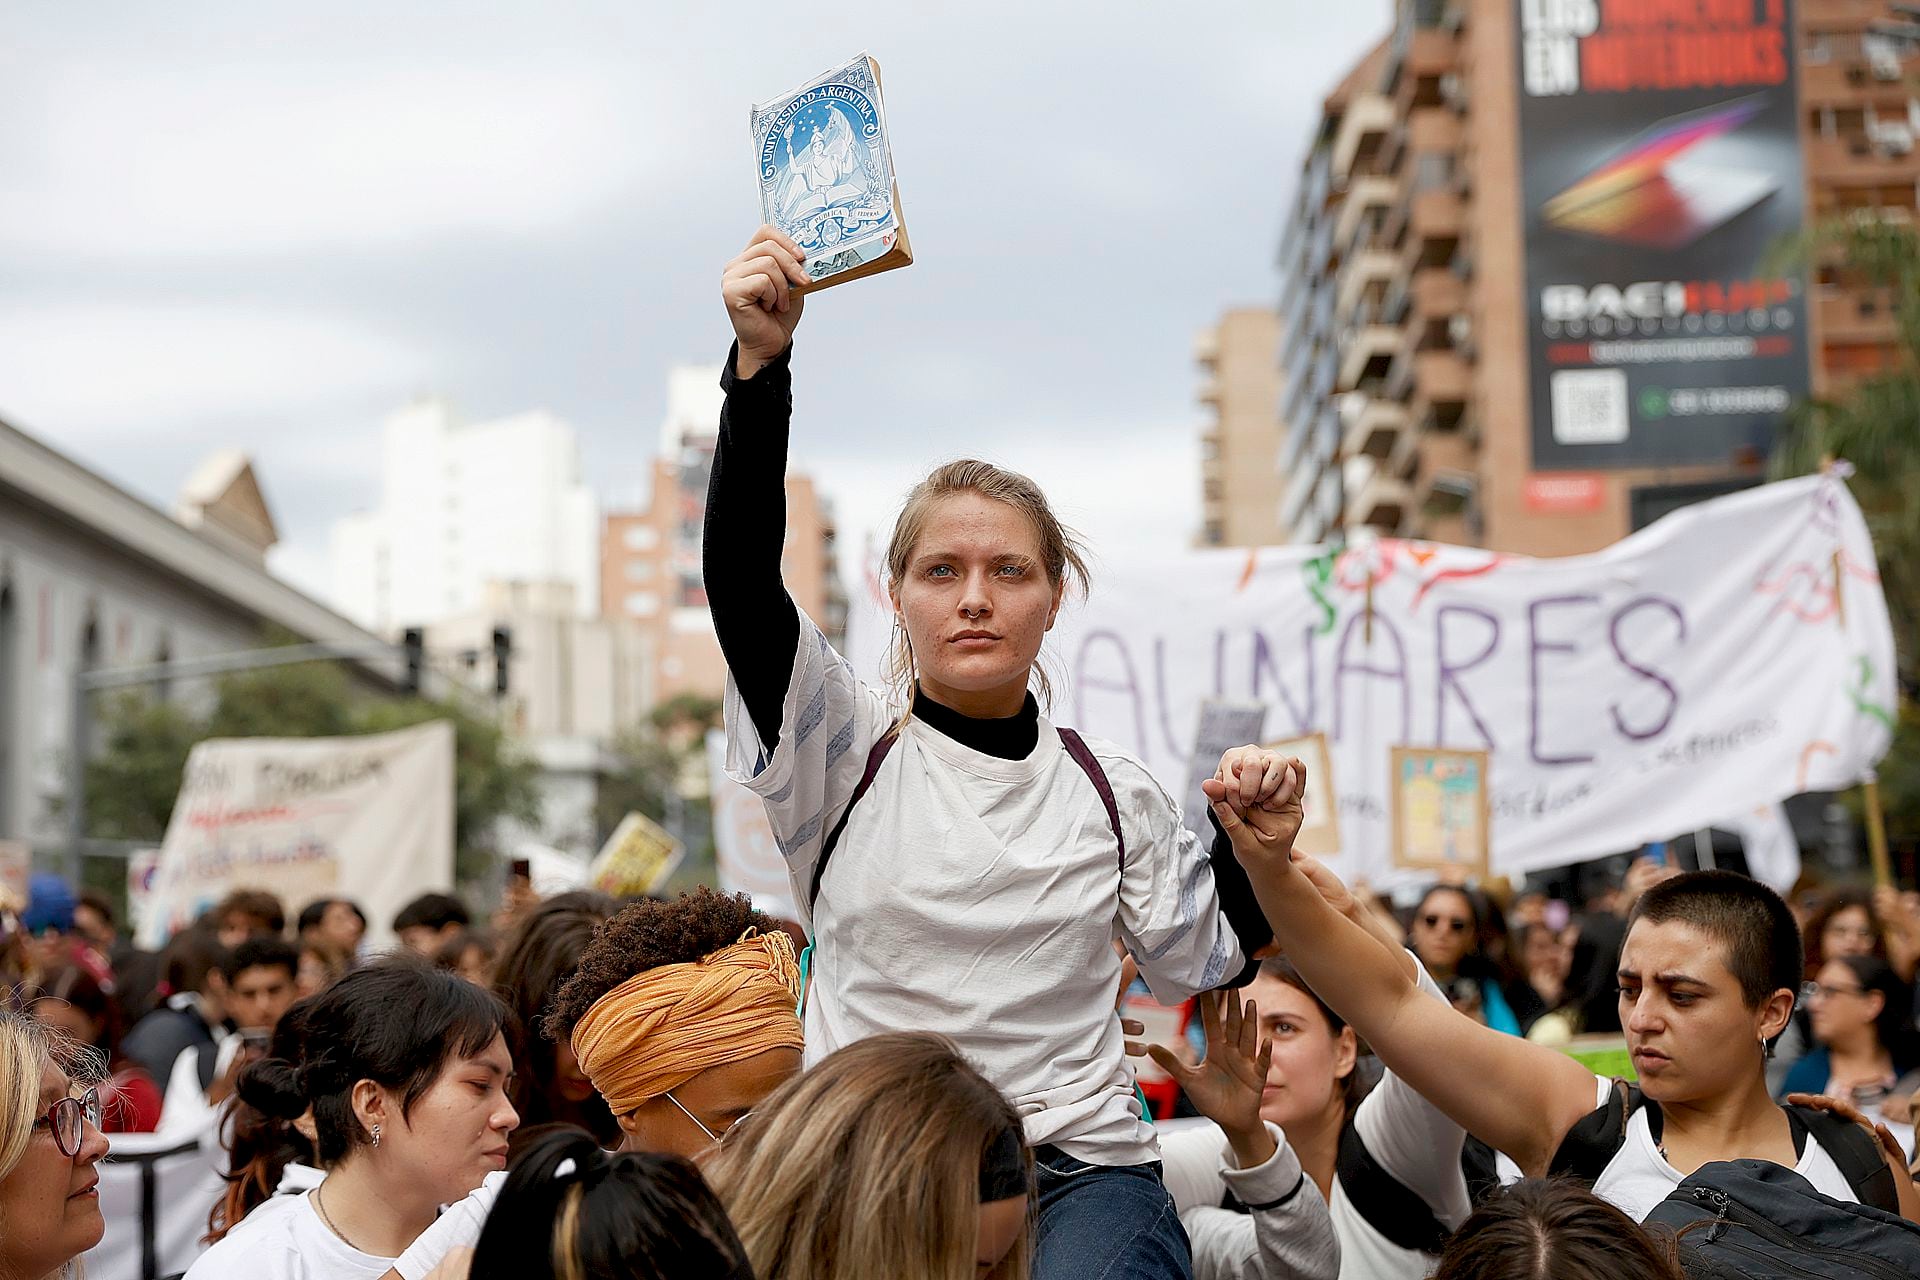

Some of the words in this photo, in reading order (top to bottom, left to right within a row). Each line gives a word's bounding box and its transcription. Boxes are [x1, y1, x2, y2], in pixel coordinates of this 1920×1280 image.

[763, 91, 816, 162] UNIVERSIDAD
[819, 86, 873, 119] ARGENTINA
[857, 210, 880, 218] FEDERAL
